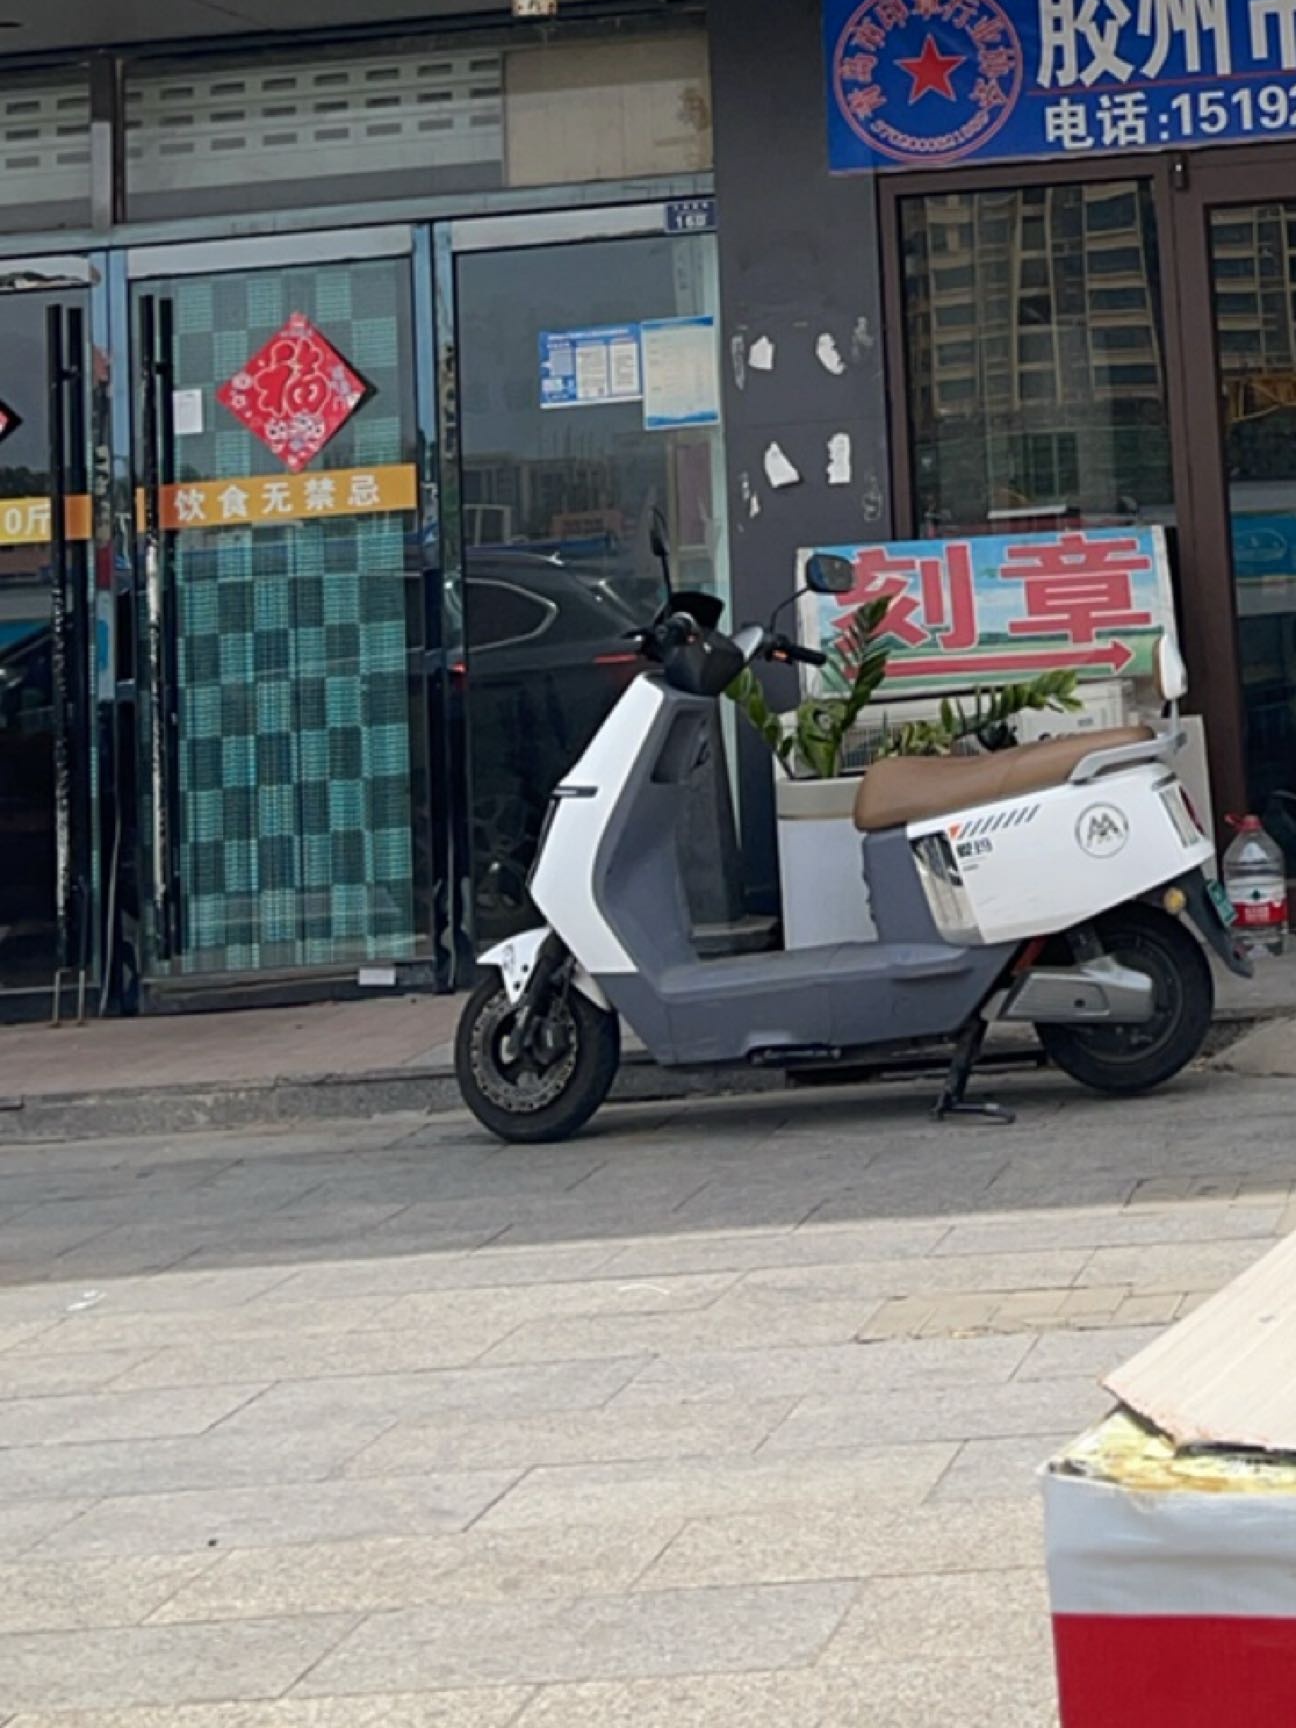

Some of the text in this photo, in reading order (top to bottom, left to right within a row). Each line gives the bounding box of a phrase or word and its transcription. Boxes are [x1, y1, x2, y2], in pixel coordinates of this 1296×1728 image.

[174, 475, 381, 522] 饮食无禁忌
[831, 534, 1152, 651] 刻章
